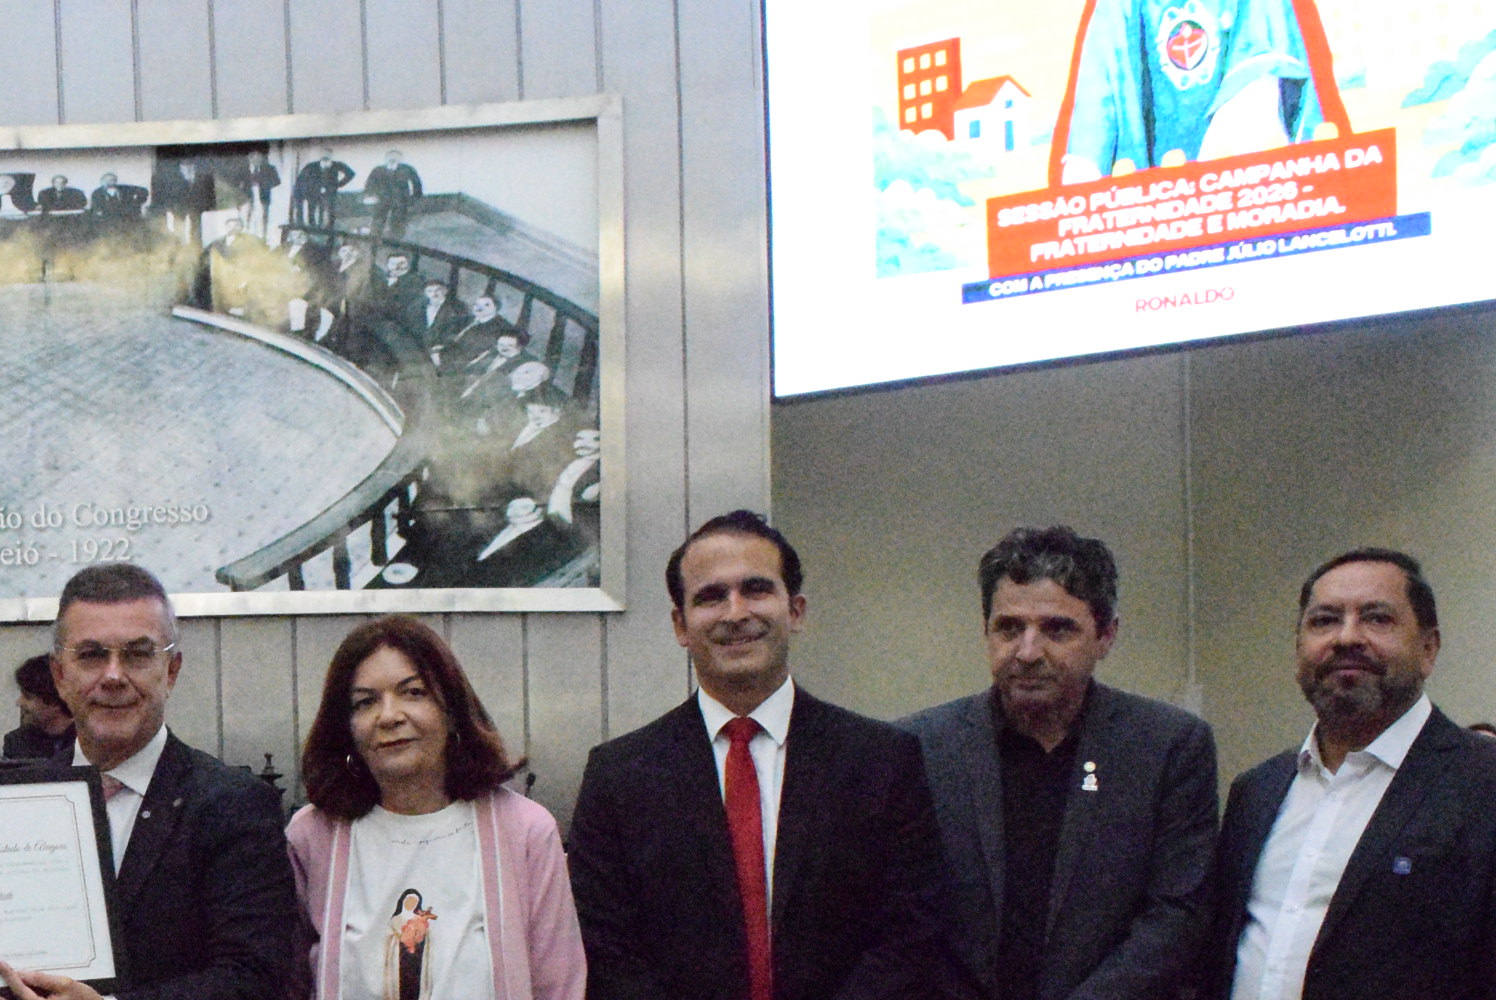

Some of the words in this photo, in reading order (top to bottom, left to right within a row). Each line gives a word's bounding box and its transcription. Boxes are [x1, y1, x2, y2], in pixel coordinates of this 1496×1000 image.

[997, 195, 1087, 228] SESSÃO
[1199, 153, 1341, 192] CAMPANHA
[1344, 145, 1383, 169] DA
[1058, 191, 1233, 237] FRATERNIDADE
[1237, 181, 1298, 208] 2026
[1030, 217, 1204, 262] FRATERNIDADE
[1207, 214, 1223, 234] E
[1226, 196, 1346, 231] MORADIA.
[988, 279, 1029, 298] COM
[1029, 276, 1044, 291] A
[1044, 261, 1135, 289] PRESENÇA
[1135, 257, 1163, 275] DO
[1164, 247, 1225, 270] PADRE
[1226, 240, 1277, 261] JÚLIO
[1135, 286, 1235, 313] RONALDO
[31, 503, 63, 528] do
[73, 501, 209, 531] Congresso
[70, 536, 132, 563] 1922
